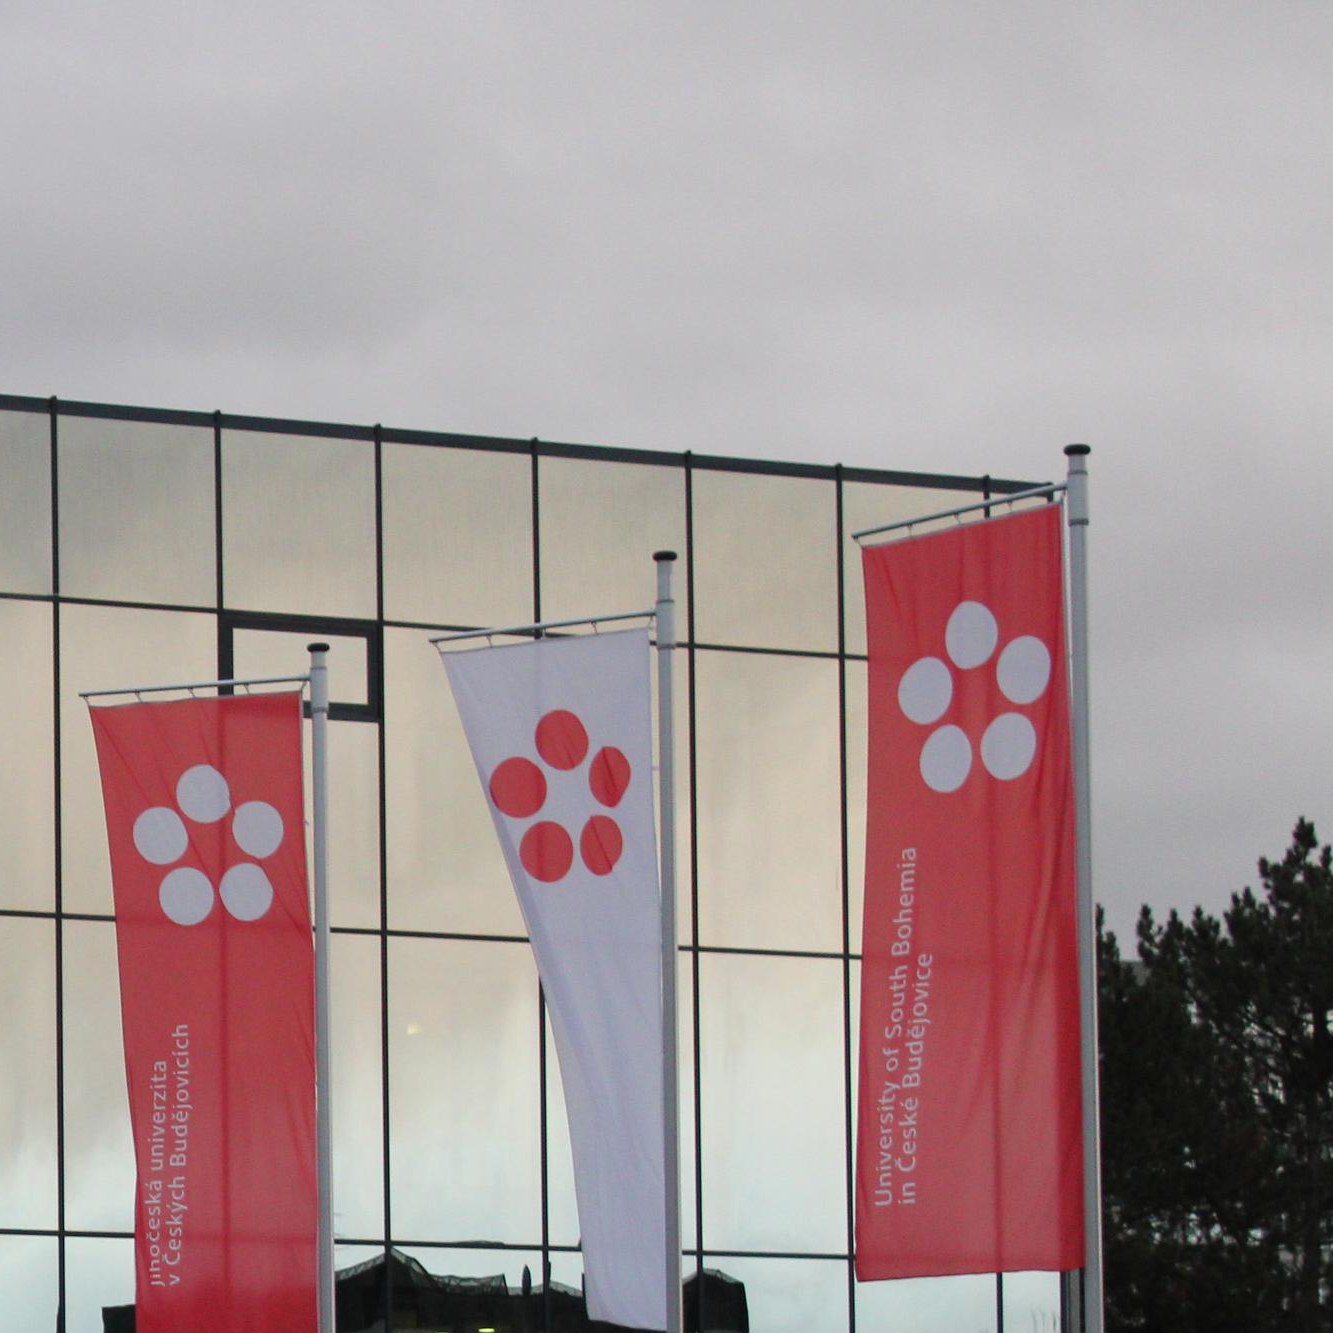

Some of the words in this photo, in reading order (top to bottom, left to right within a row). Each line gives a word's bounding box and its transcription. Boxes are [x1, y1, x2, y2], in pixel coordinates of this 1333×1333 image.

[891, 847, 917, 957] Bohemia
[884, 965, 908, 1040] South
[902, 952, 933, 1088] Budějovice
[169, 1023, 193, 1167] Budějovicích
[882, 1047, 899, 1072] of
[147, 1060, 167, 1171] univerzita
[875, 1081, 900, 1207] University
[894, 1097, 918, 1173] České
[144, 1180, 166, 1287] Jihočeská
[162, 1175, 189, 1266] Českých
[898, 1181, 917, 1205] in
[168, 1273, 182, 1287] v
